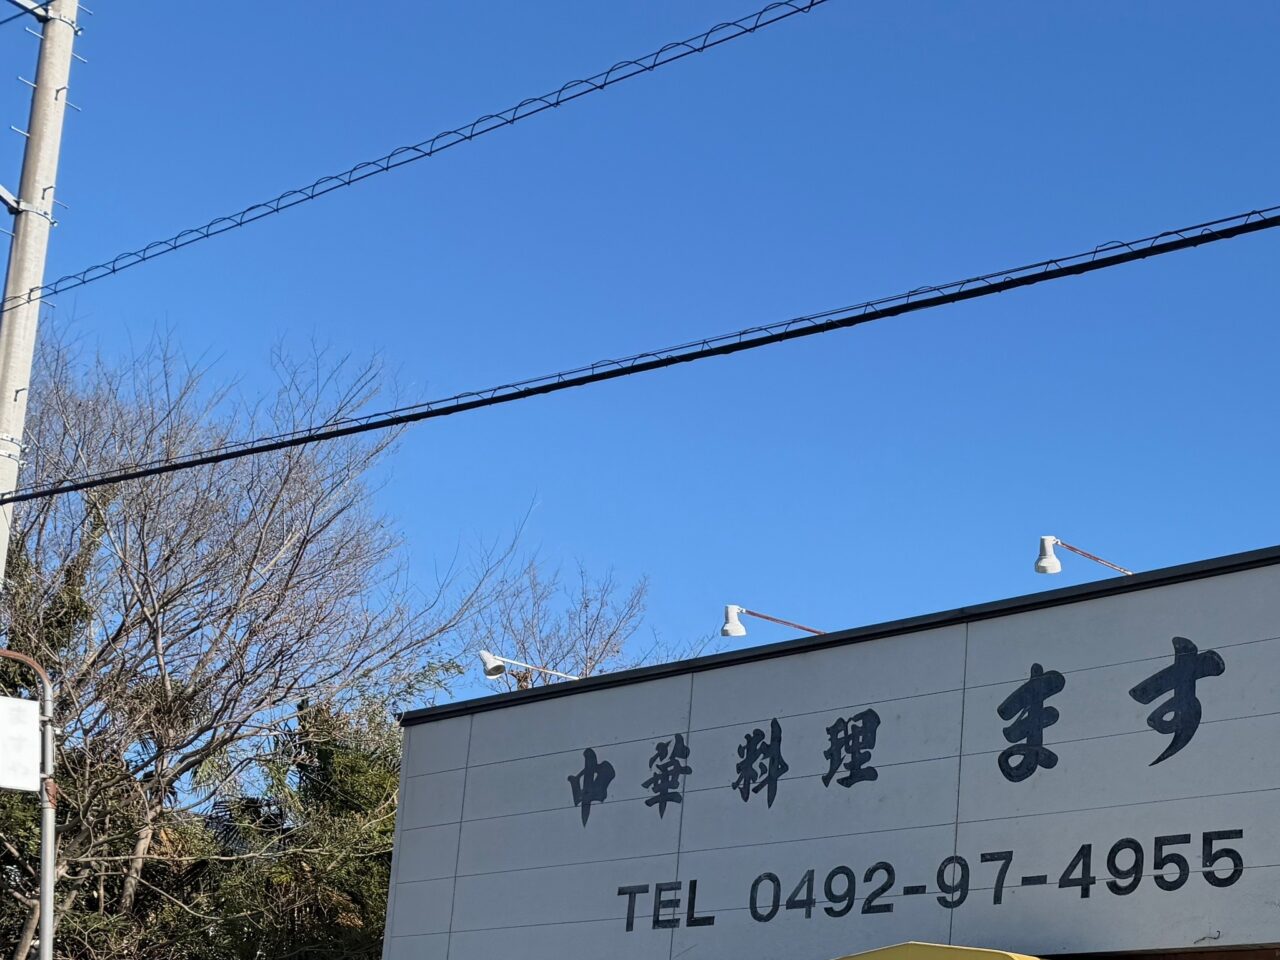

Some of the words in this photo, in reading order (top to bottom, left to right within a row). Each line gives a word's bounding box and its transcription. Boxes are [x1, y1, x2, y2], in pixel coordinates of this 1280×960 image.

[567, 708, 882, 828] 中華料理
[617, 880, 715, 932] TEL
[749, 829, 1244, 924] 0492-97-4955
